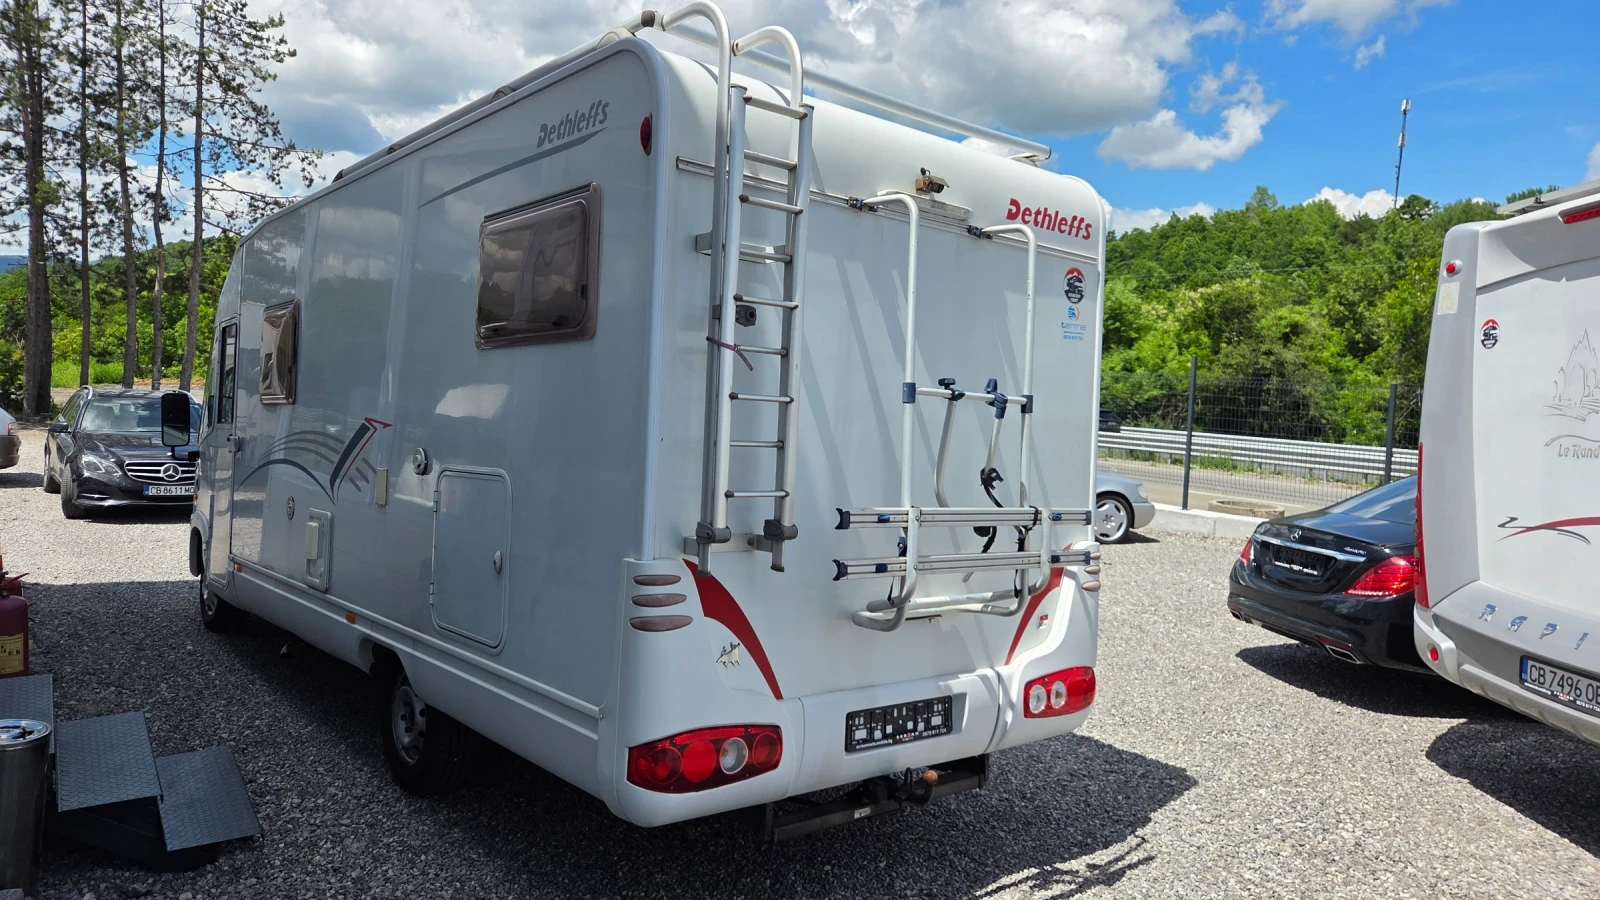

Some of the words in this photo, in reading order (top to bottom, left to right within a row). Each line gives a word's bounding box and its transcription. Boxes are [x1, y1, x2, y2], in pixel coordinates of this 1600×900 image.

[537, 99, 610, 149] Dethleffs
[1006, 197, 1093, 240] Dethleffs
[1558, 444, 1570, 457] Le
[150, 486, 162, 495] CB
[162, 486, 183, 495] 8611
[1529, 664, 1546, 686] CB
[1548, 669, 1583, 697] 7496
